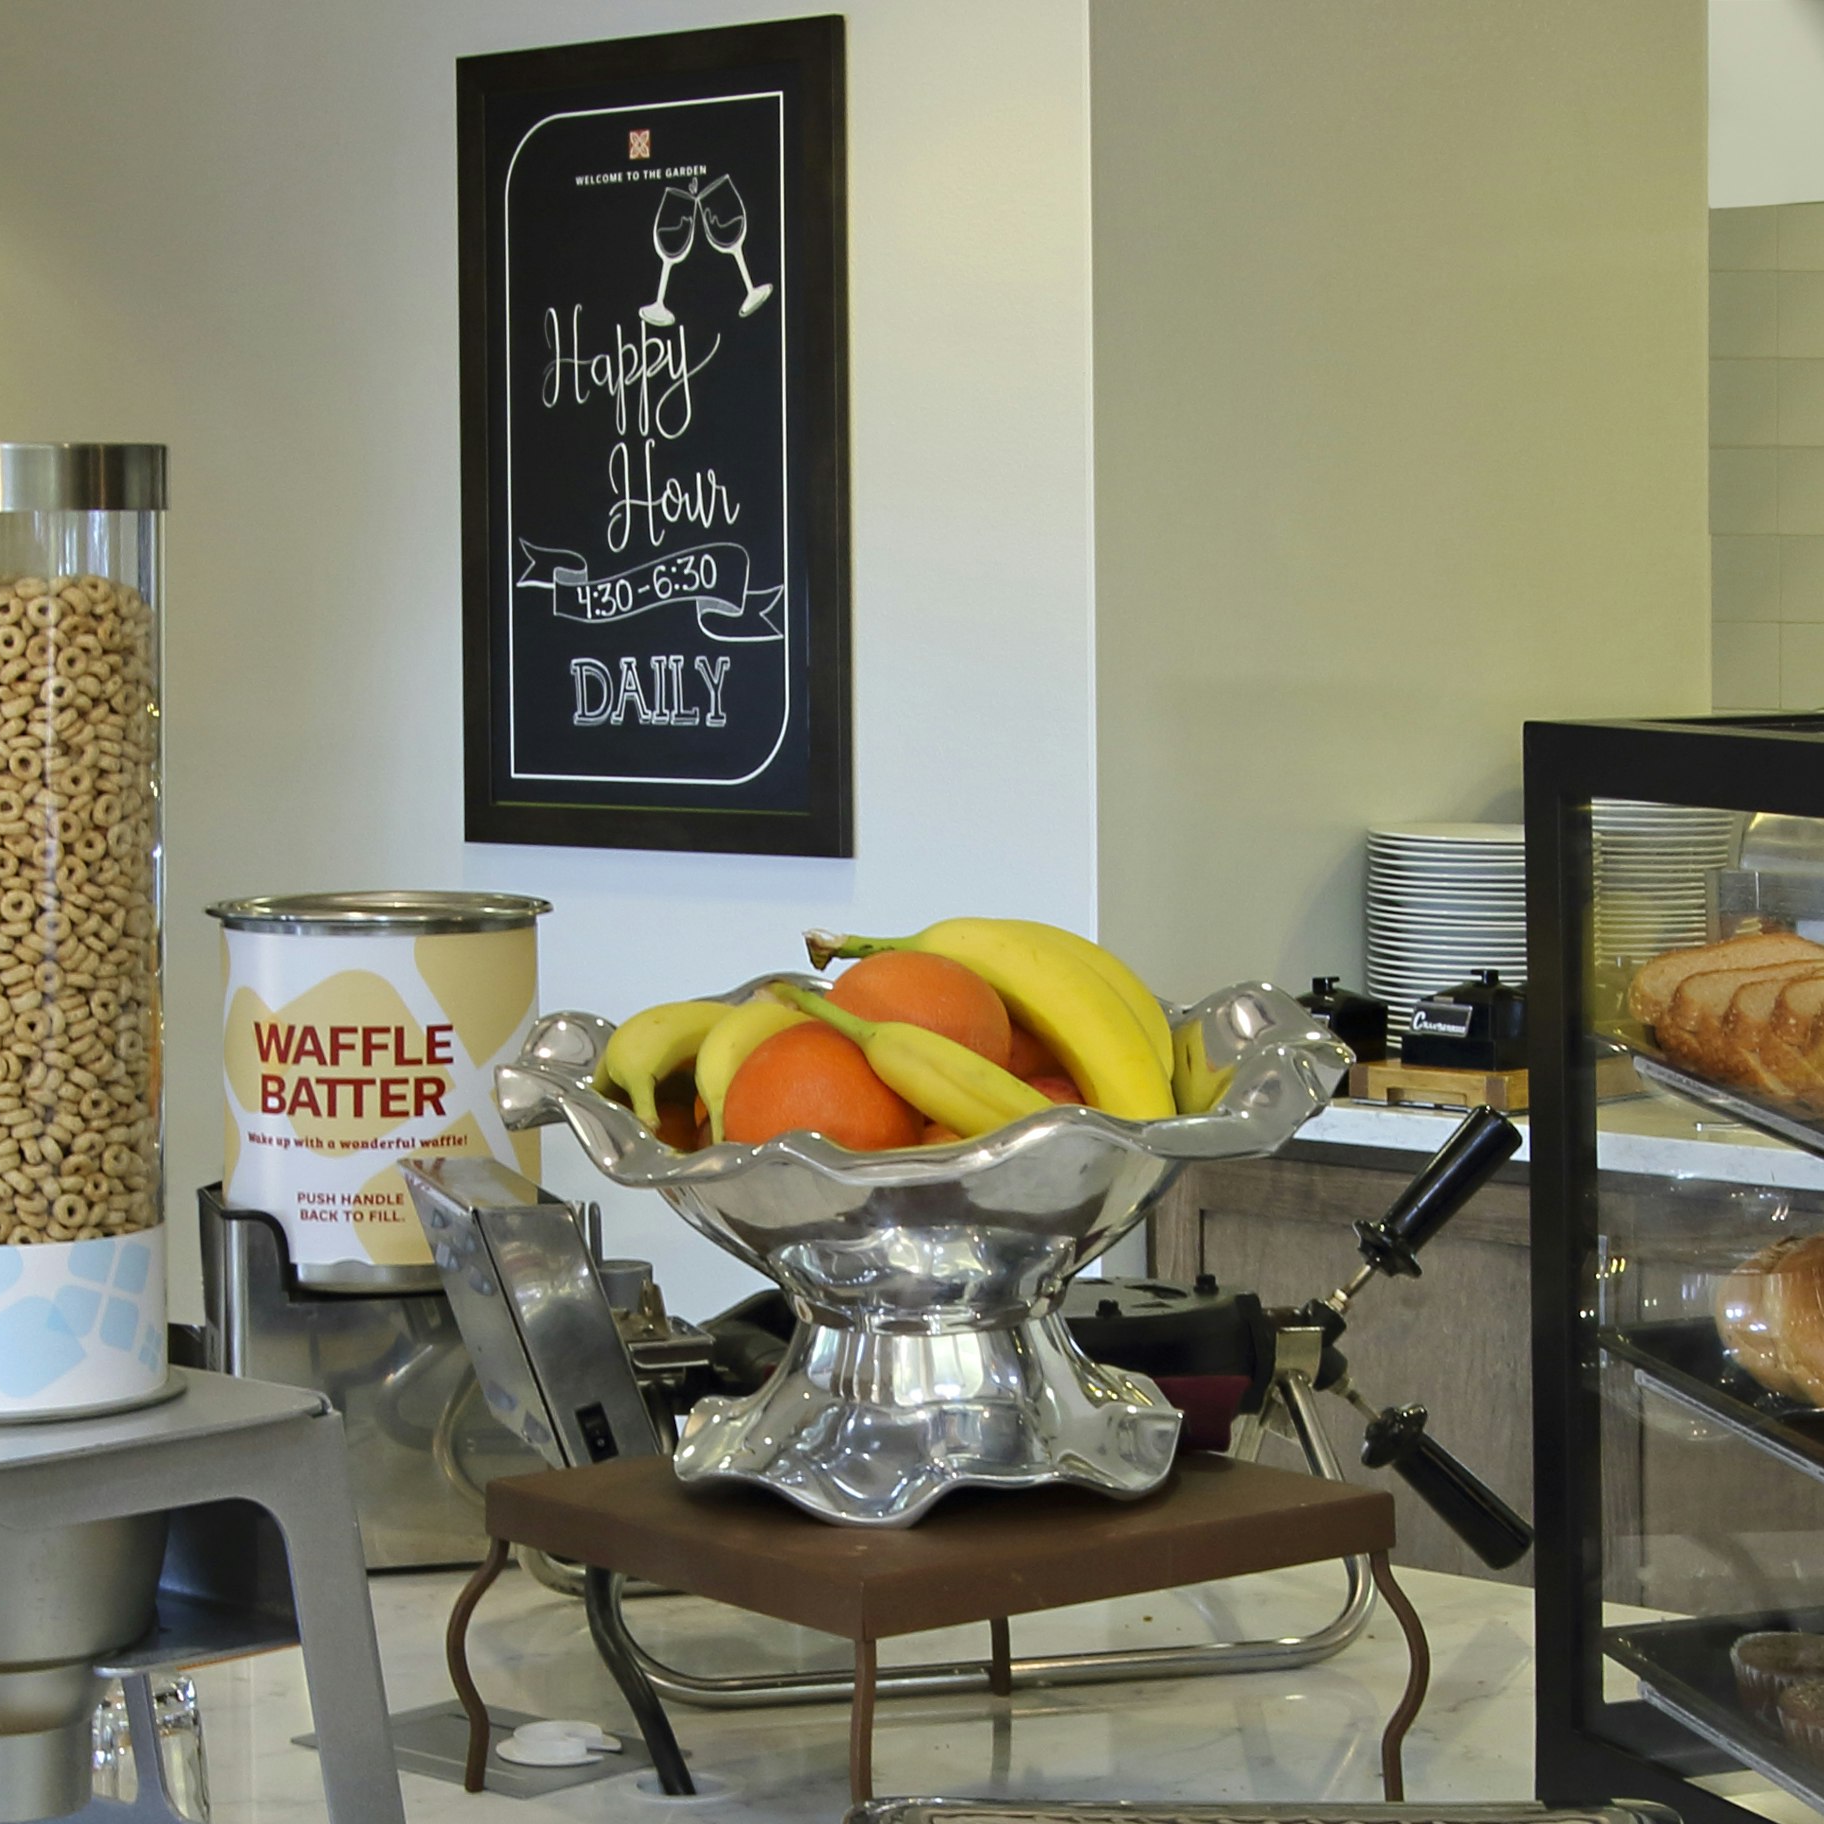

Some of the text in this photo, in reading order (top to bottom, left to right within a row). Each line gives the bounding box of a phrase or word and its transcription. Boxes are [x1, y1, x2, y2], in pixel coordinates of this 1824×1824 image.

[575, 164, 707, 186] WELCOME TO THE GARDEN
[542, 303, 721, 439] Happy
[607, 438, 740, 553] Hour
[570, 654, 731, 728] DAILY
[253, 1021, 455, 1067] WAFFLE
[260, 1073, 447, 1118] BATTER
[248, 1130, 468, 1149] Wake up with a wonderful waffle!
[297, 1191, 405, 1206] PUSH HANDLE
[300, 1208, 406, 1224] BACK TO FILL.
